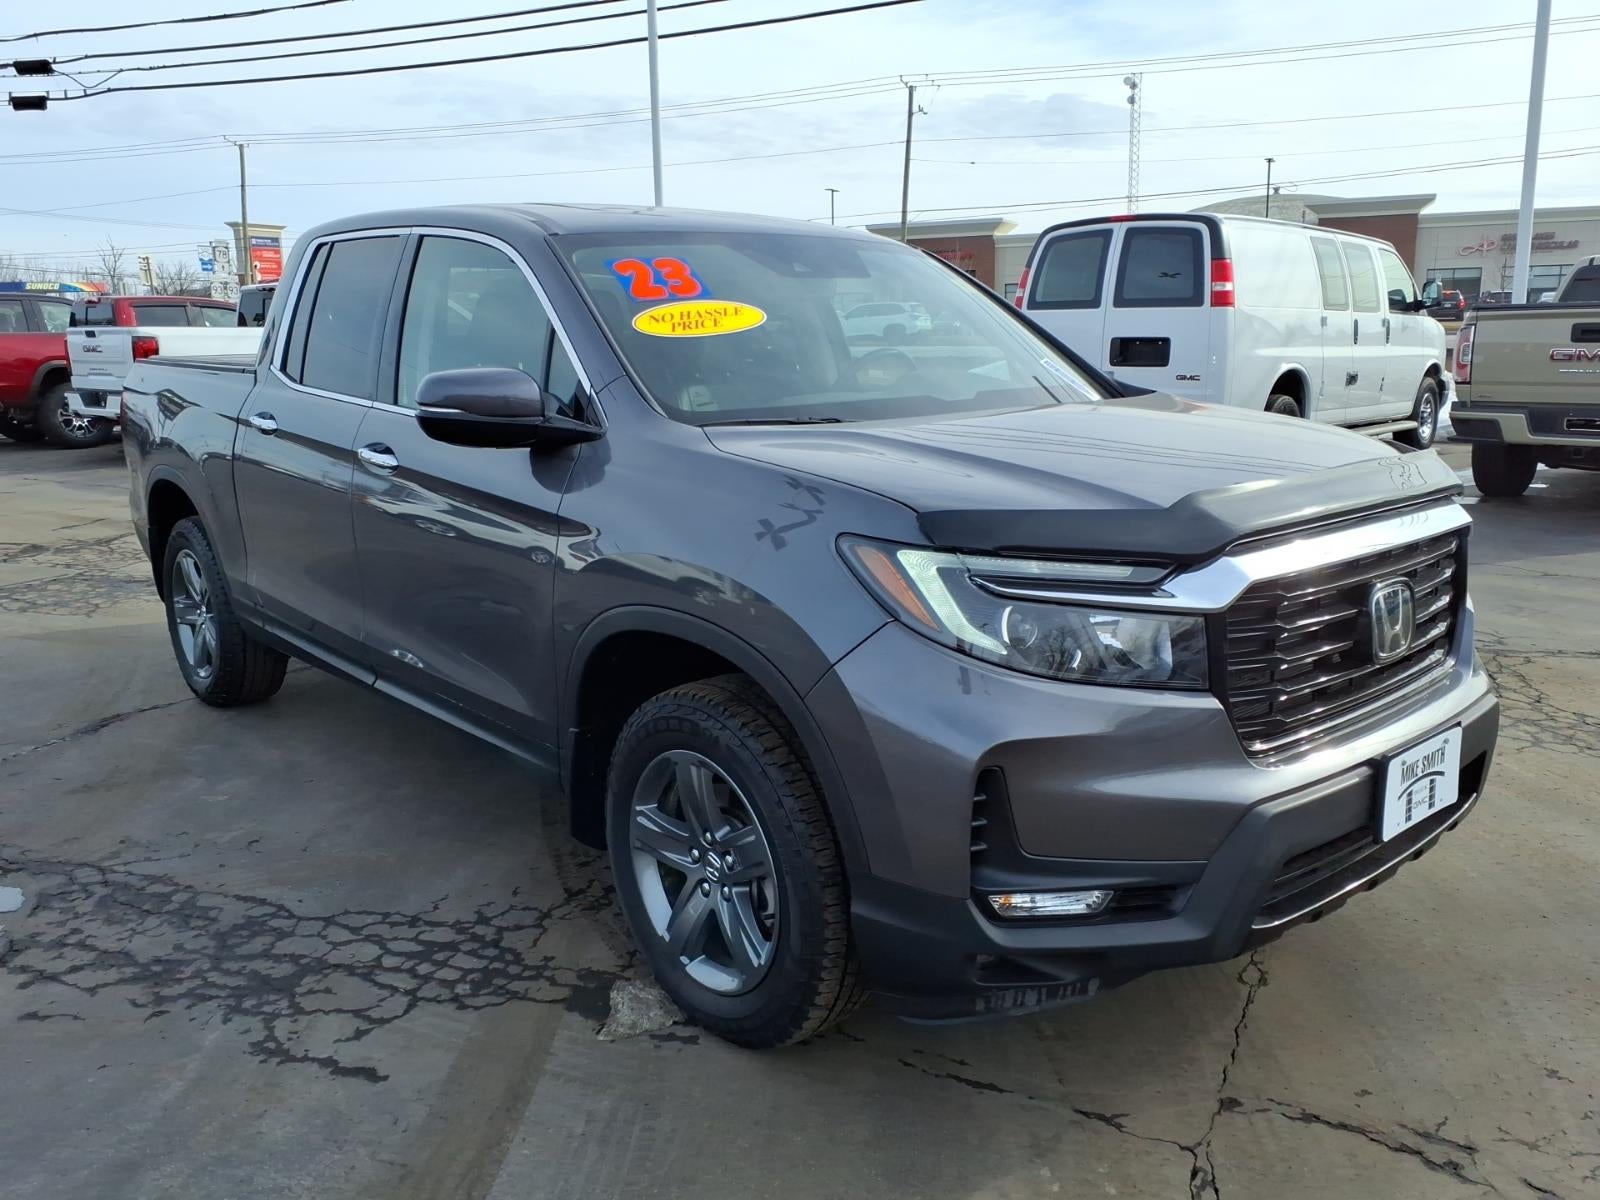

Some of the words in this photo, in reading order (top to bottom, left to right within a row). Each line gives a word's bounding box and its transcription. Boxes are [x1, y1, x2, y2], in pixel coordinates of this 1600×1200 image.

[613, 257, 702, 300] 23
[25, 282, 60, 290] SUNOCO
[649, 313, 674, 324] NO
[680, 307, 743, 321] HASSLE
[671, 318, 722, 332] PRICE
[82, 344, 103, 353] GMC
[1176, 374, 1201, 382] GMC
[1400, 759, 1420, 787] MIKE
[1421, 745, 1446, 774] SMITH
